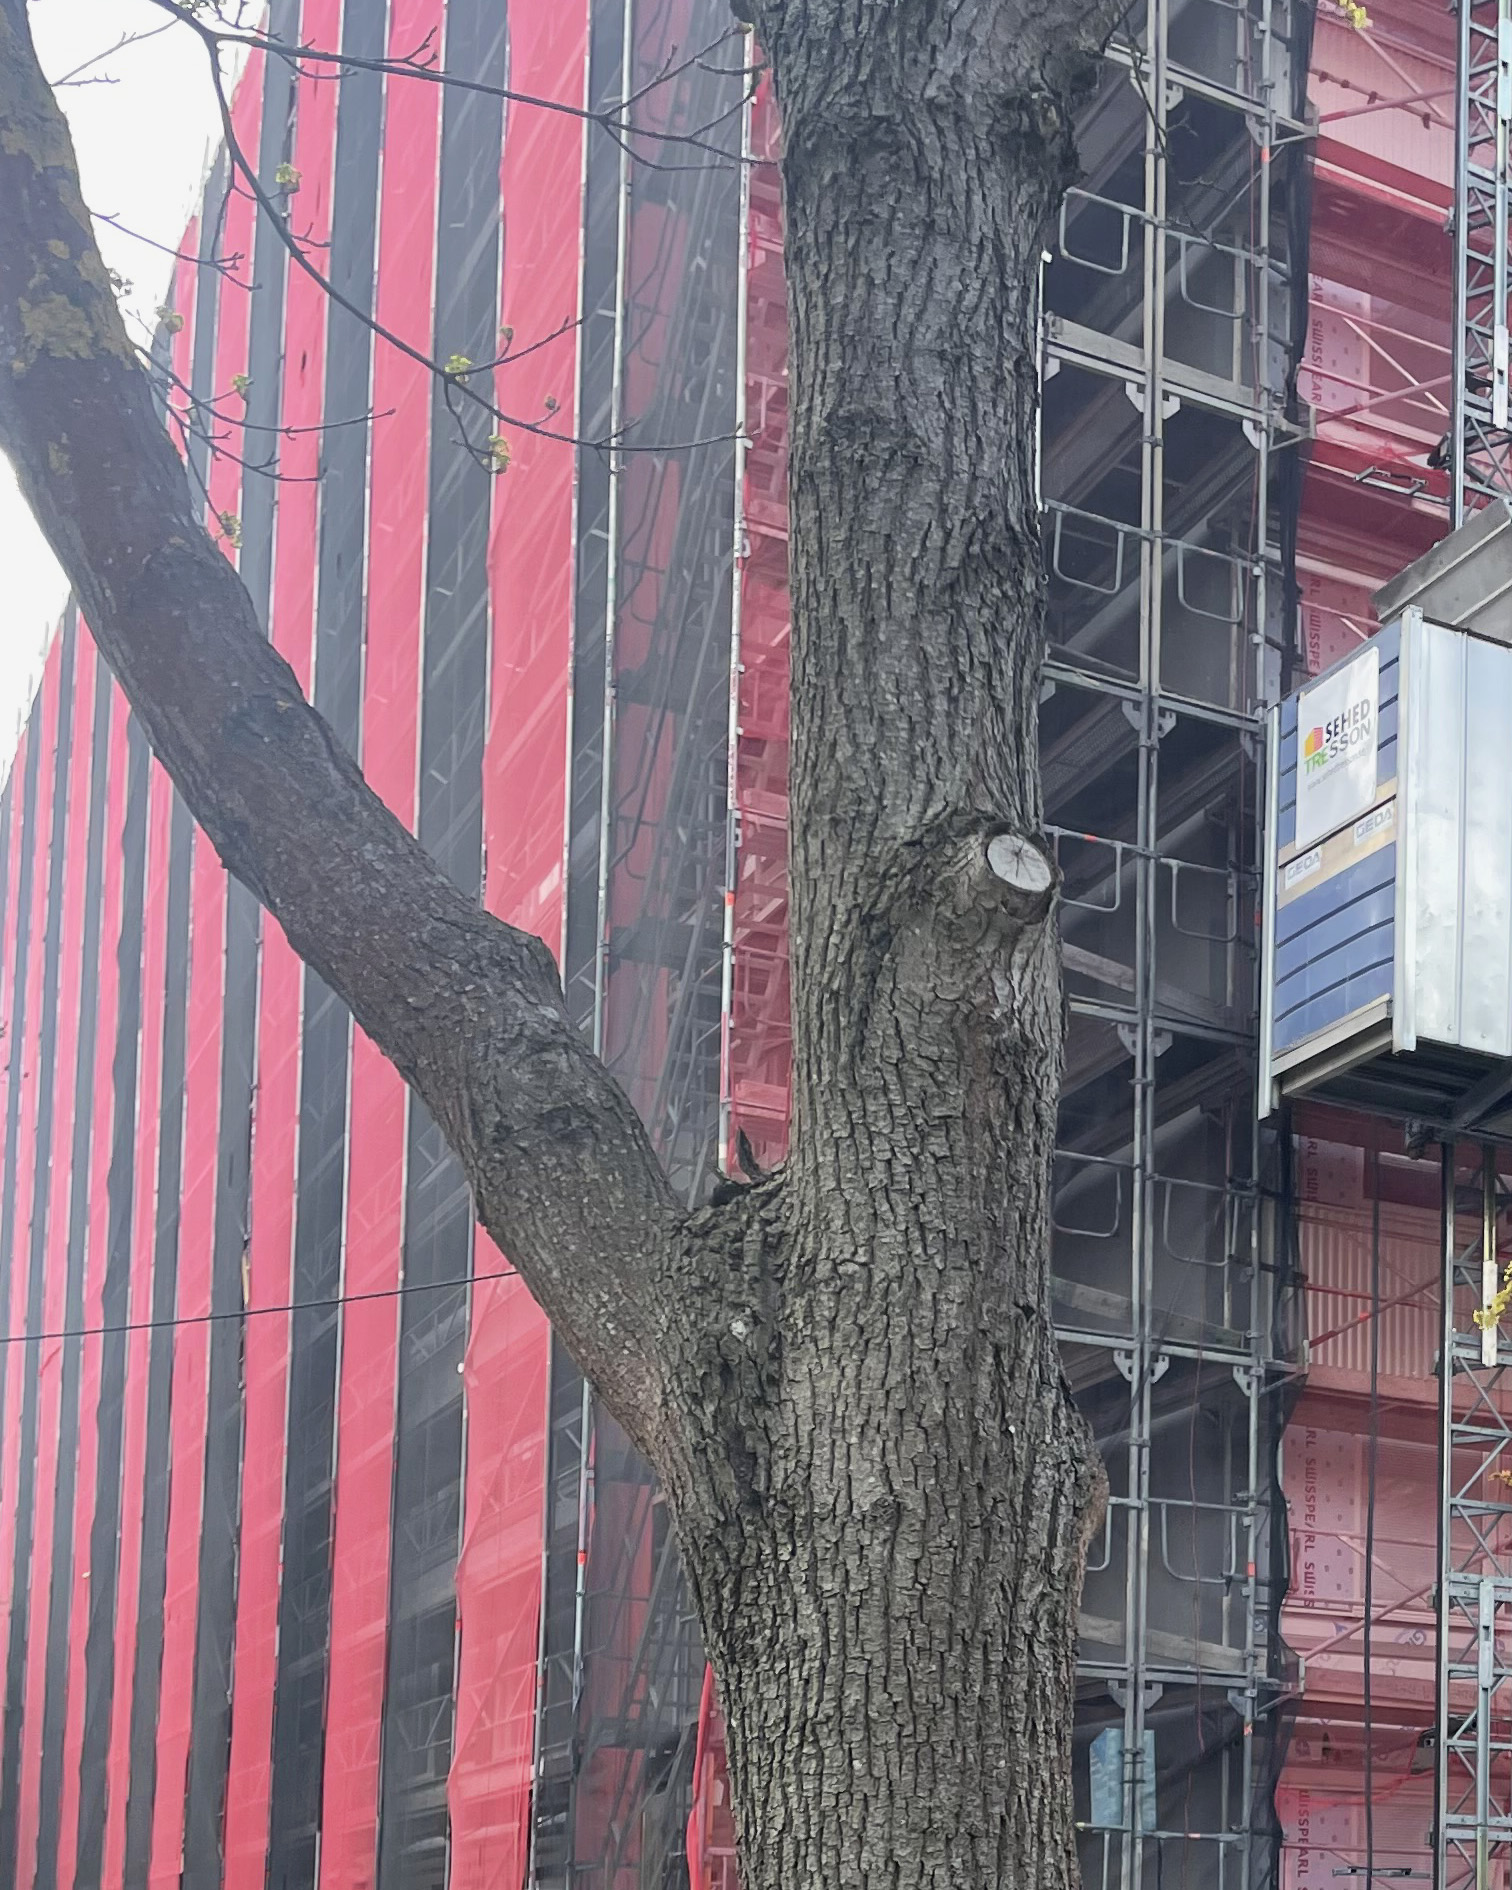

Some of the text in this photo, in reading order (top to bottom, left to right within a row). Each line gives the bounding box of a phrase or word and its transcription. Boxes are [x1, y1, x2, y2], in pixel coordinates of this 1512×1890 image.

[1325, 698, 1370, 743] SEHED
[1304, 719, 1371, 775] TRESSON
[1355, 806, 1392, 839] GEDA
[1286, 851, 1319, 881] GEDA
